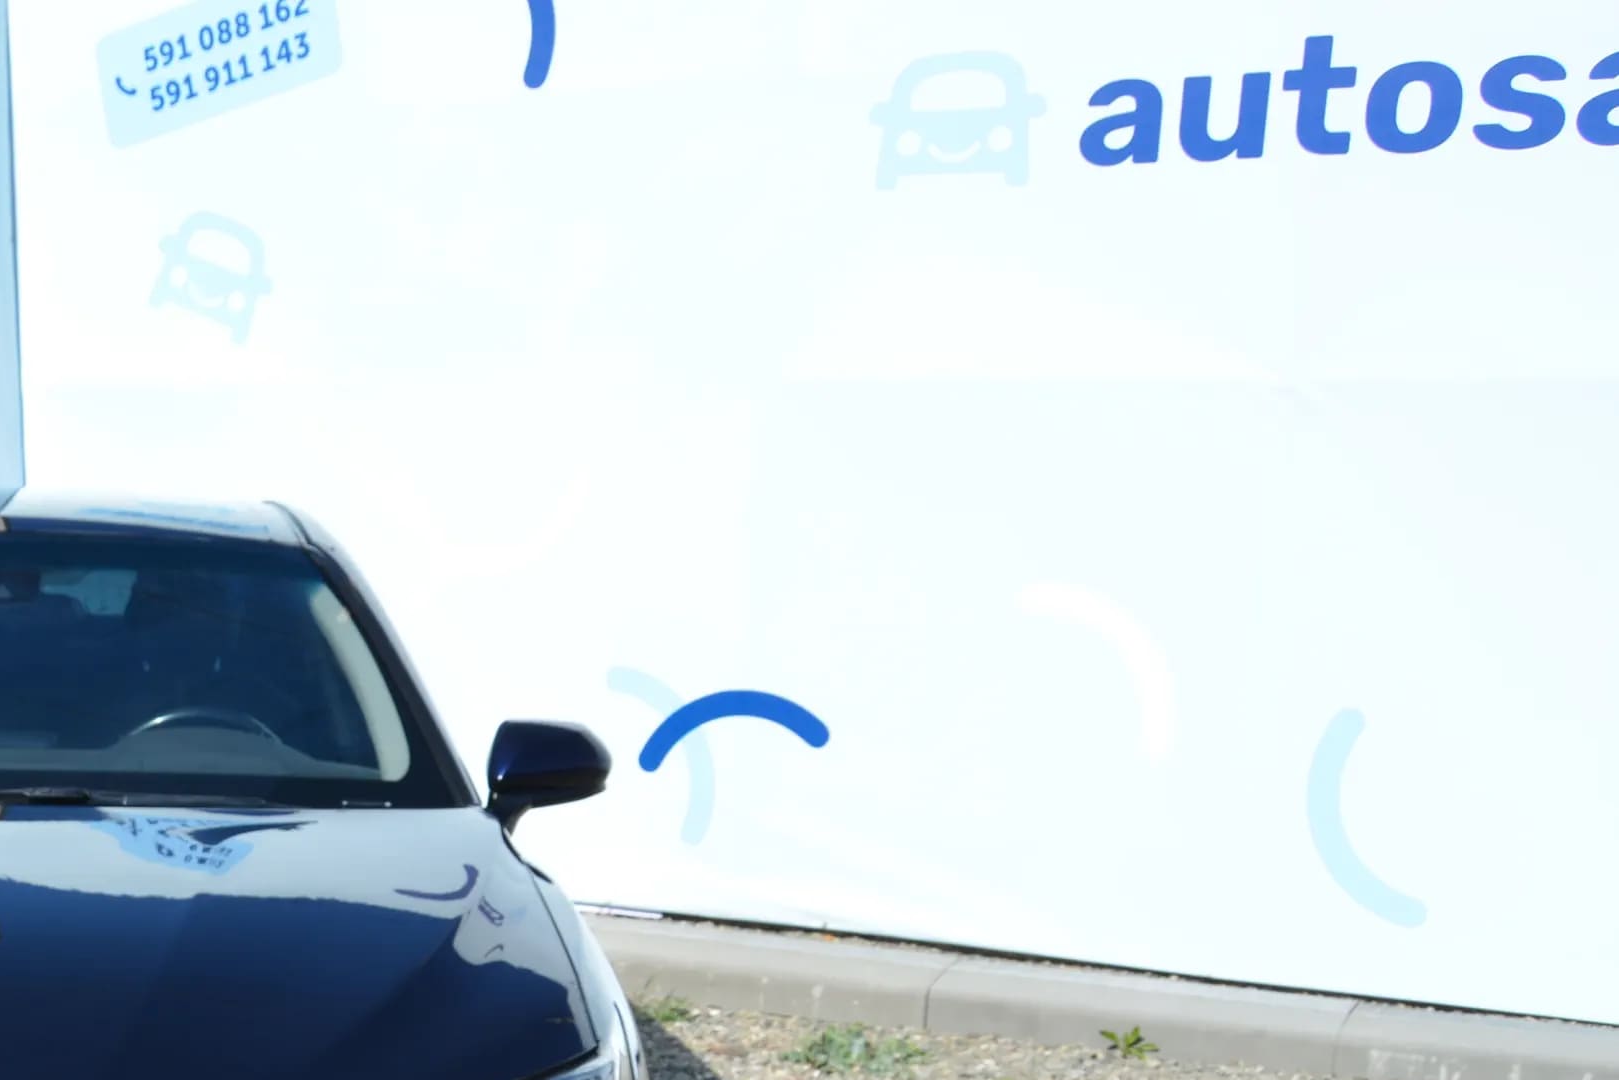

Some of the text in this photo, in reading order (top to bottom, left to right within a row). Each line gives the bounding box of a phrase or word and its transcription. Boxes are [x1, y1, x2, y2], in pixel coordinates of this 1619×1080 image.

[145, 34, 192, 72] 591
[199, 12, 251, 52] 088
[150, 32, 311, 112] 591 911 143
